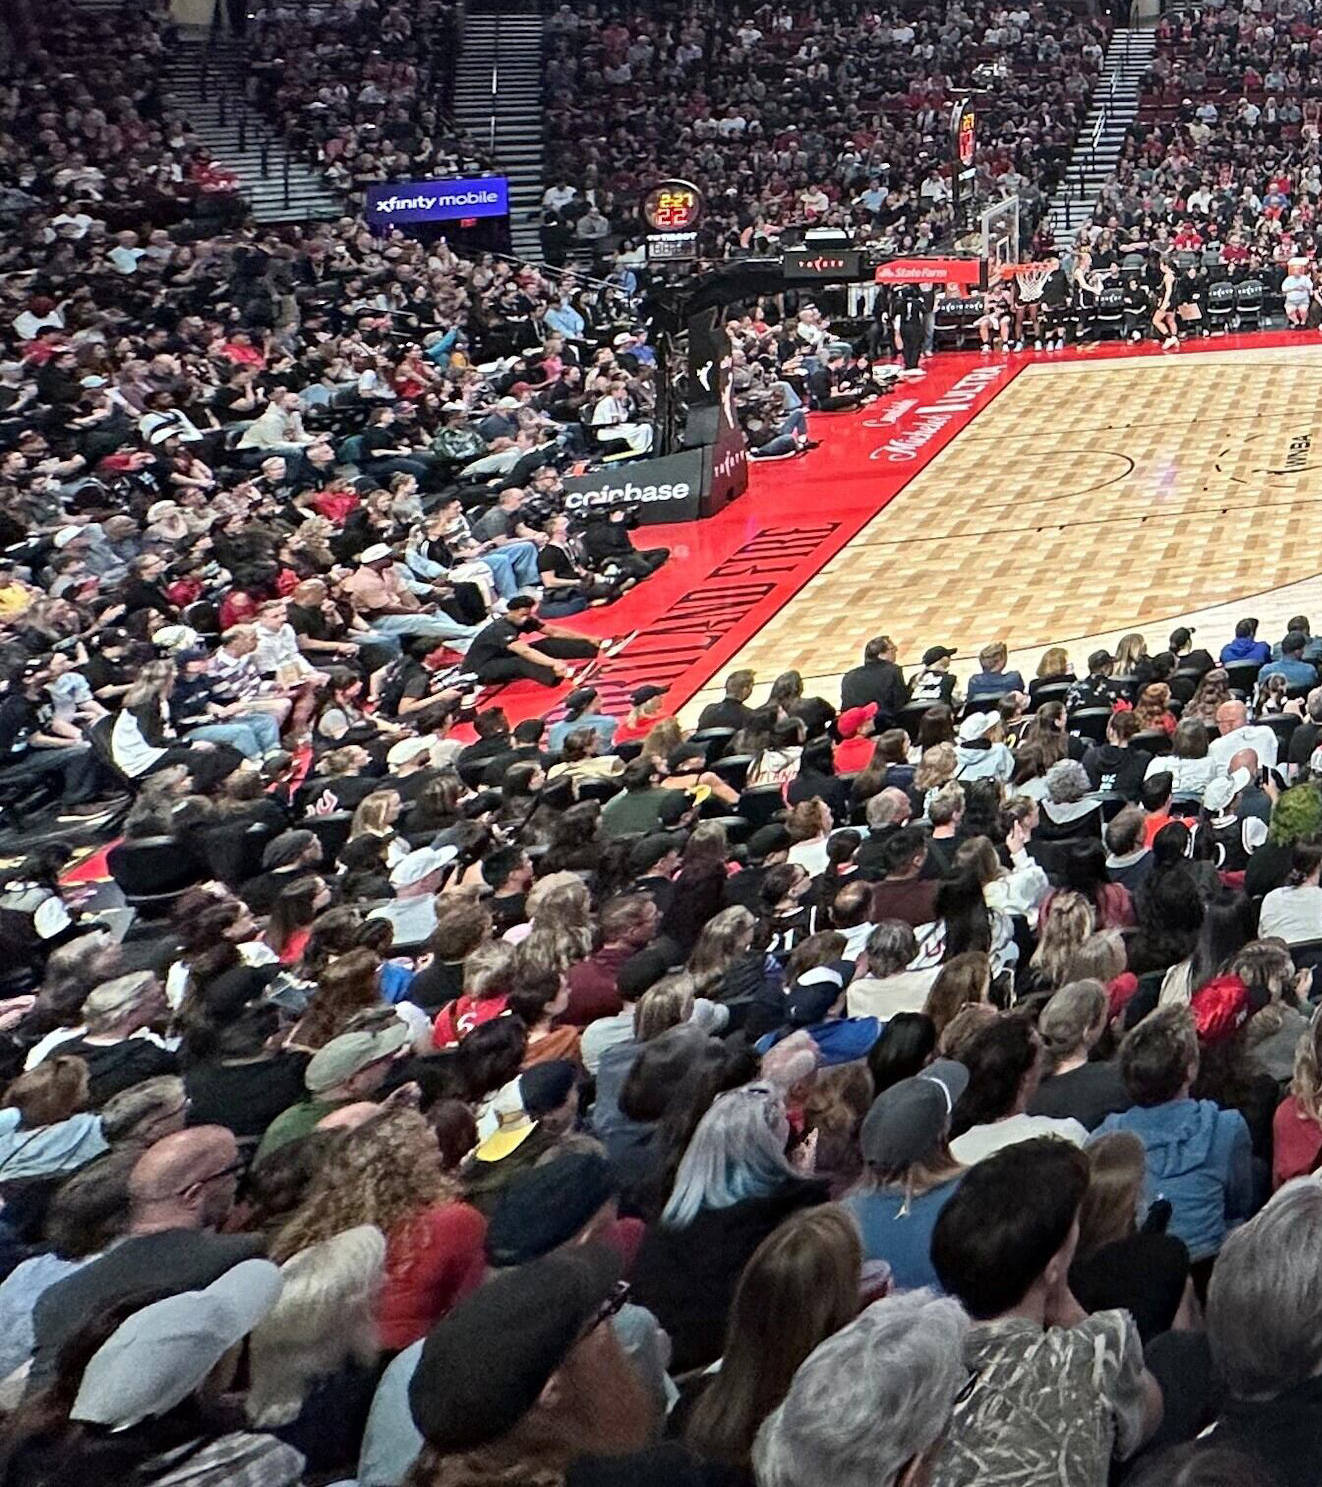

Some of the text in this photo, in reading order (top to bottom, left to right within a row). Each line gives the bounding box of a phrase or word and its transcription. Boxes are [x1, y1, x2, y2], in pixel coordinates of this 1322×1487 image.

[375, 189, 498, 214] xfinity mobile
[656, 207, 688, 226] 22
[894, 267, 948, 278] State Farm
